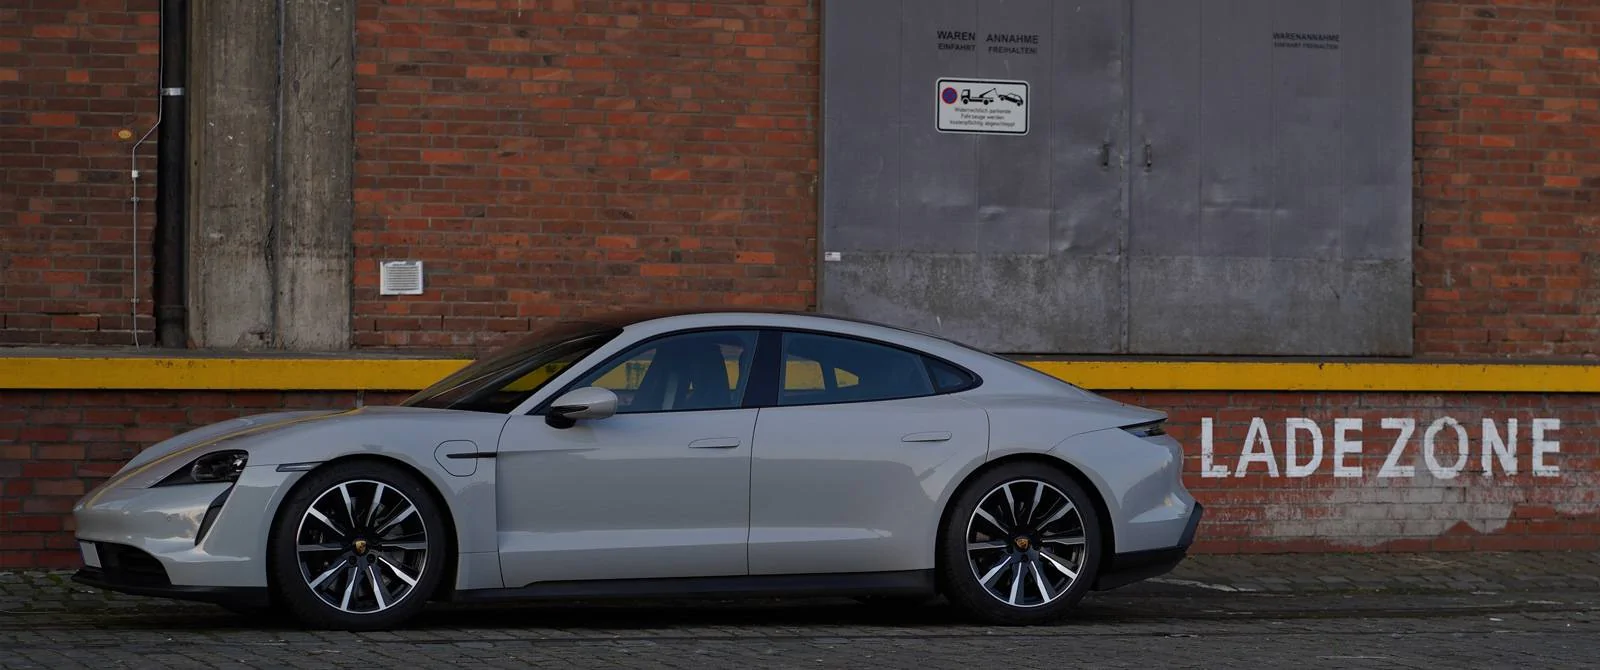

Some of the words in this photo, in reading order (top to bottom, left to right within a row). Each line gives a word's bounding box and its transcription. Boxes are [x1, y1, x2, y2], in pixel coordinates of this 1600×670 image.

[937, 31, 976, 41] WAREN
[986, 33, 1040, 44] ANNAHME
[937, 42, 976, 51] EINFAHRT
[1200, 416, 1562, 480] LADEZONE
